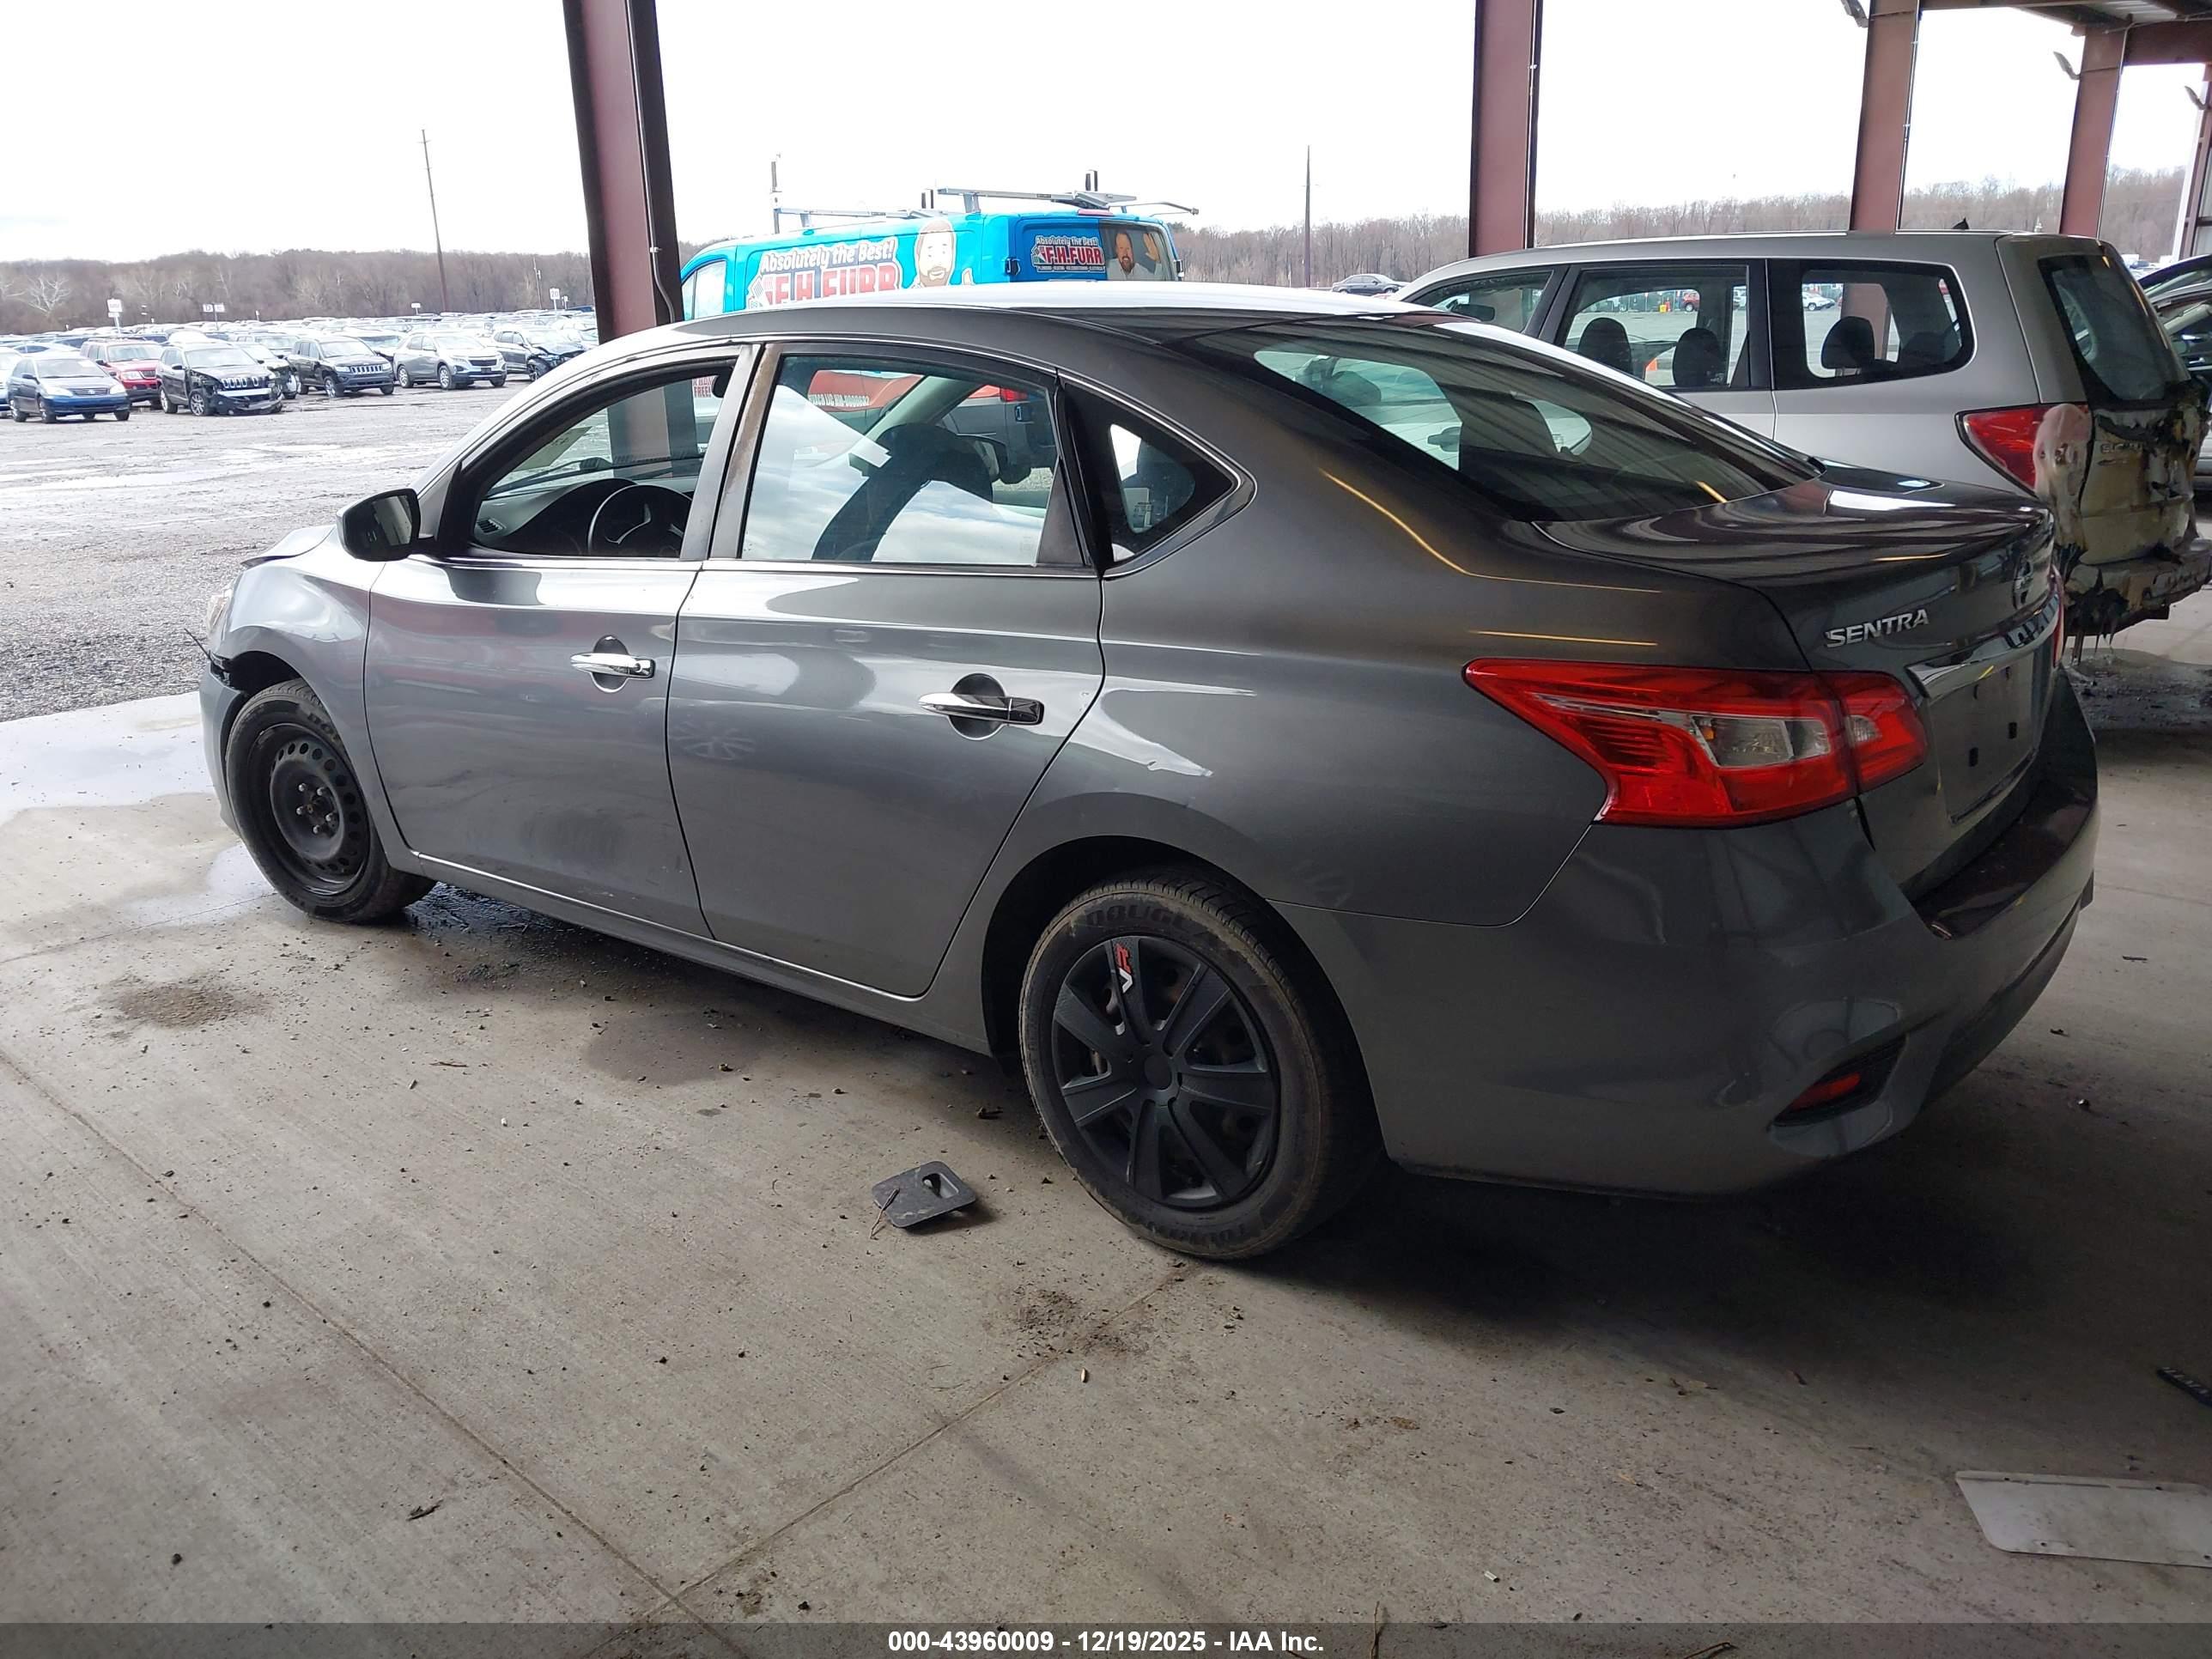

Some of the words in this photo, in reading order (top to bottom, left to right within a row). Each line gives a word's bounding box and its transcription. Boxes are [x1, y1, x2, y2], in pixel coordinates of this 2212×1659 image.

[761, 247, 829, 273] Absolutely
[830, 244, 854, 264] the
[858, 240, 896, 262] Best!
[1036, 236, 1071, 246] Absolutely
[1072, 237, 1081, 246] the
[1825, 609, 1929, 648] SENTRA
